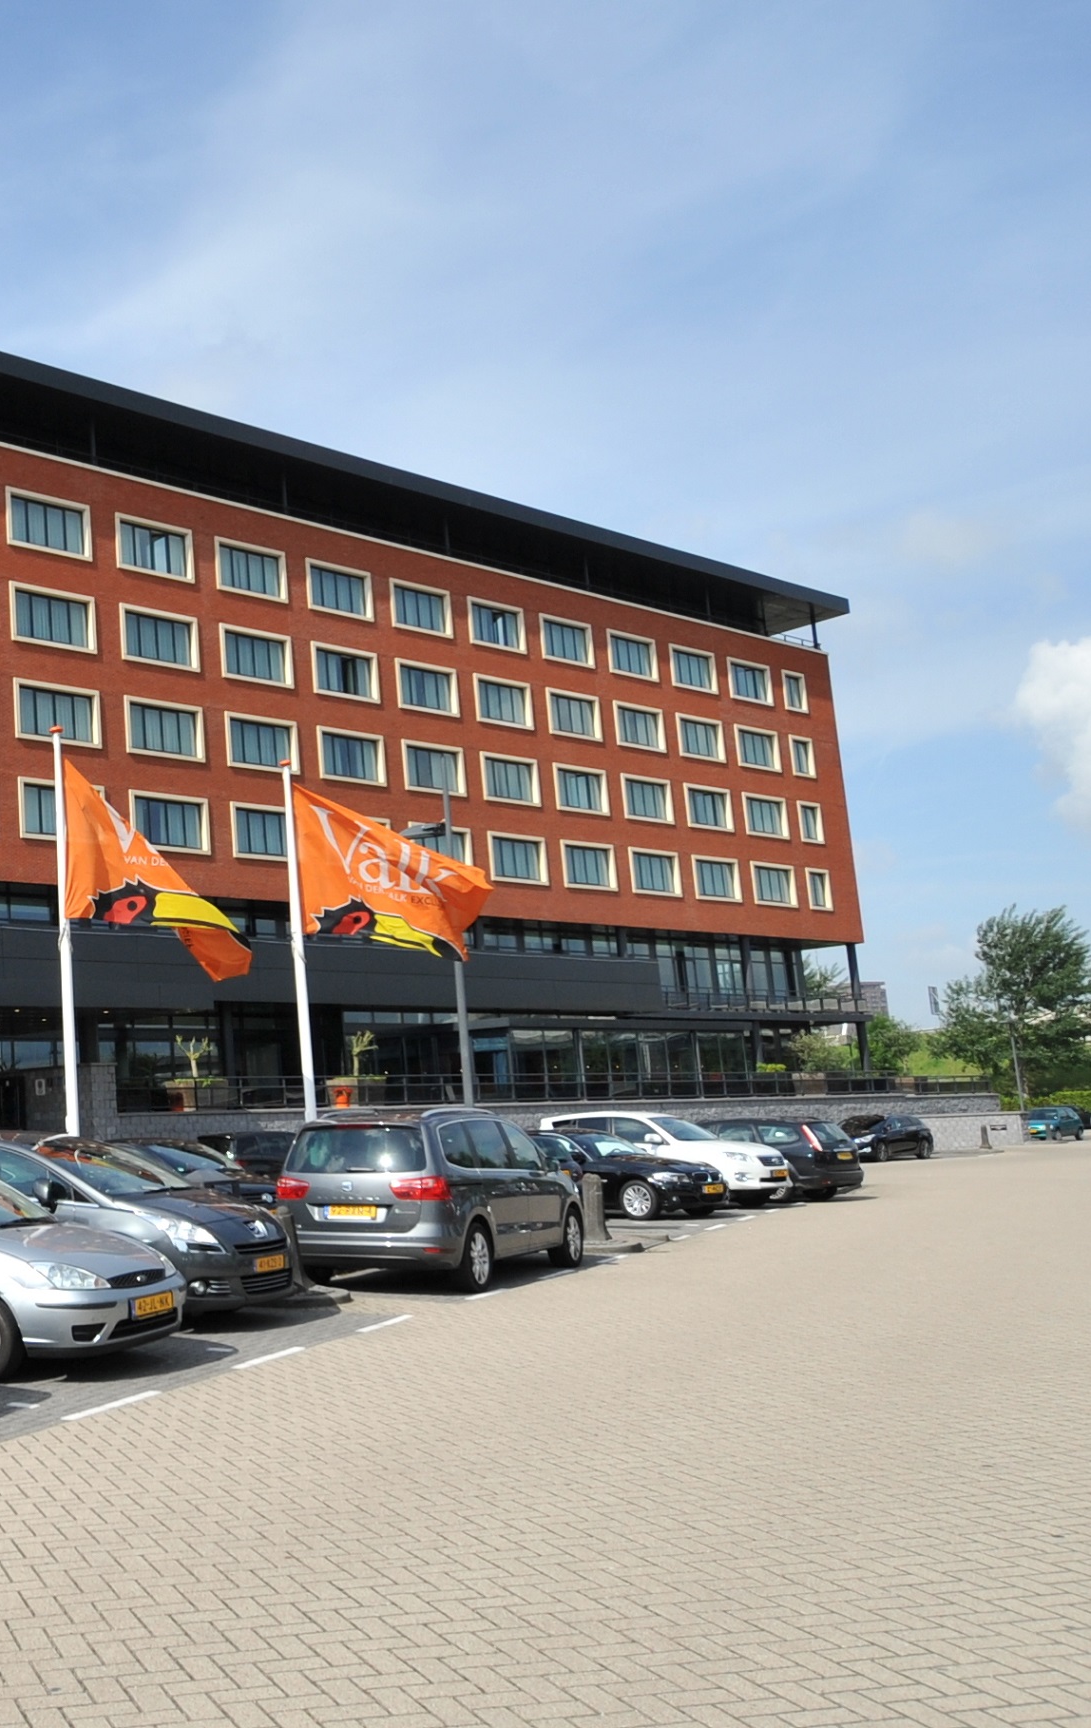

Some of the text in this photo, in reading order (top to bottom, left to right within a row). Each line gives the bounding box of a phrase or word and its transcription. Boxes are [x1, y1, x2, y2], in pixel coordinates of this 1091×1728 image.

[124, 855, 170, 867] VAN DE
[310, 805, 457, 902] Valk
